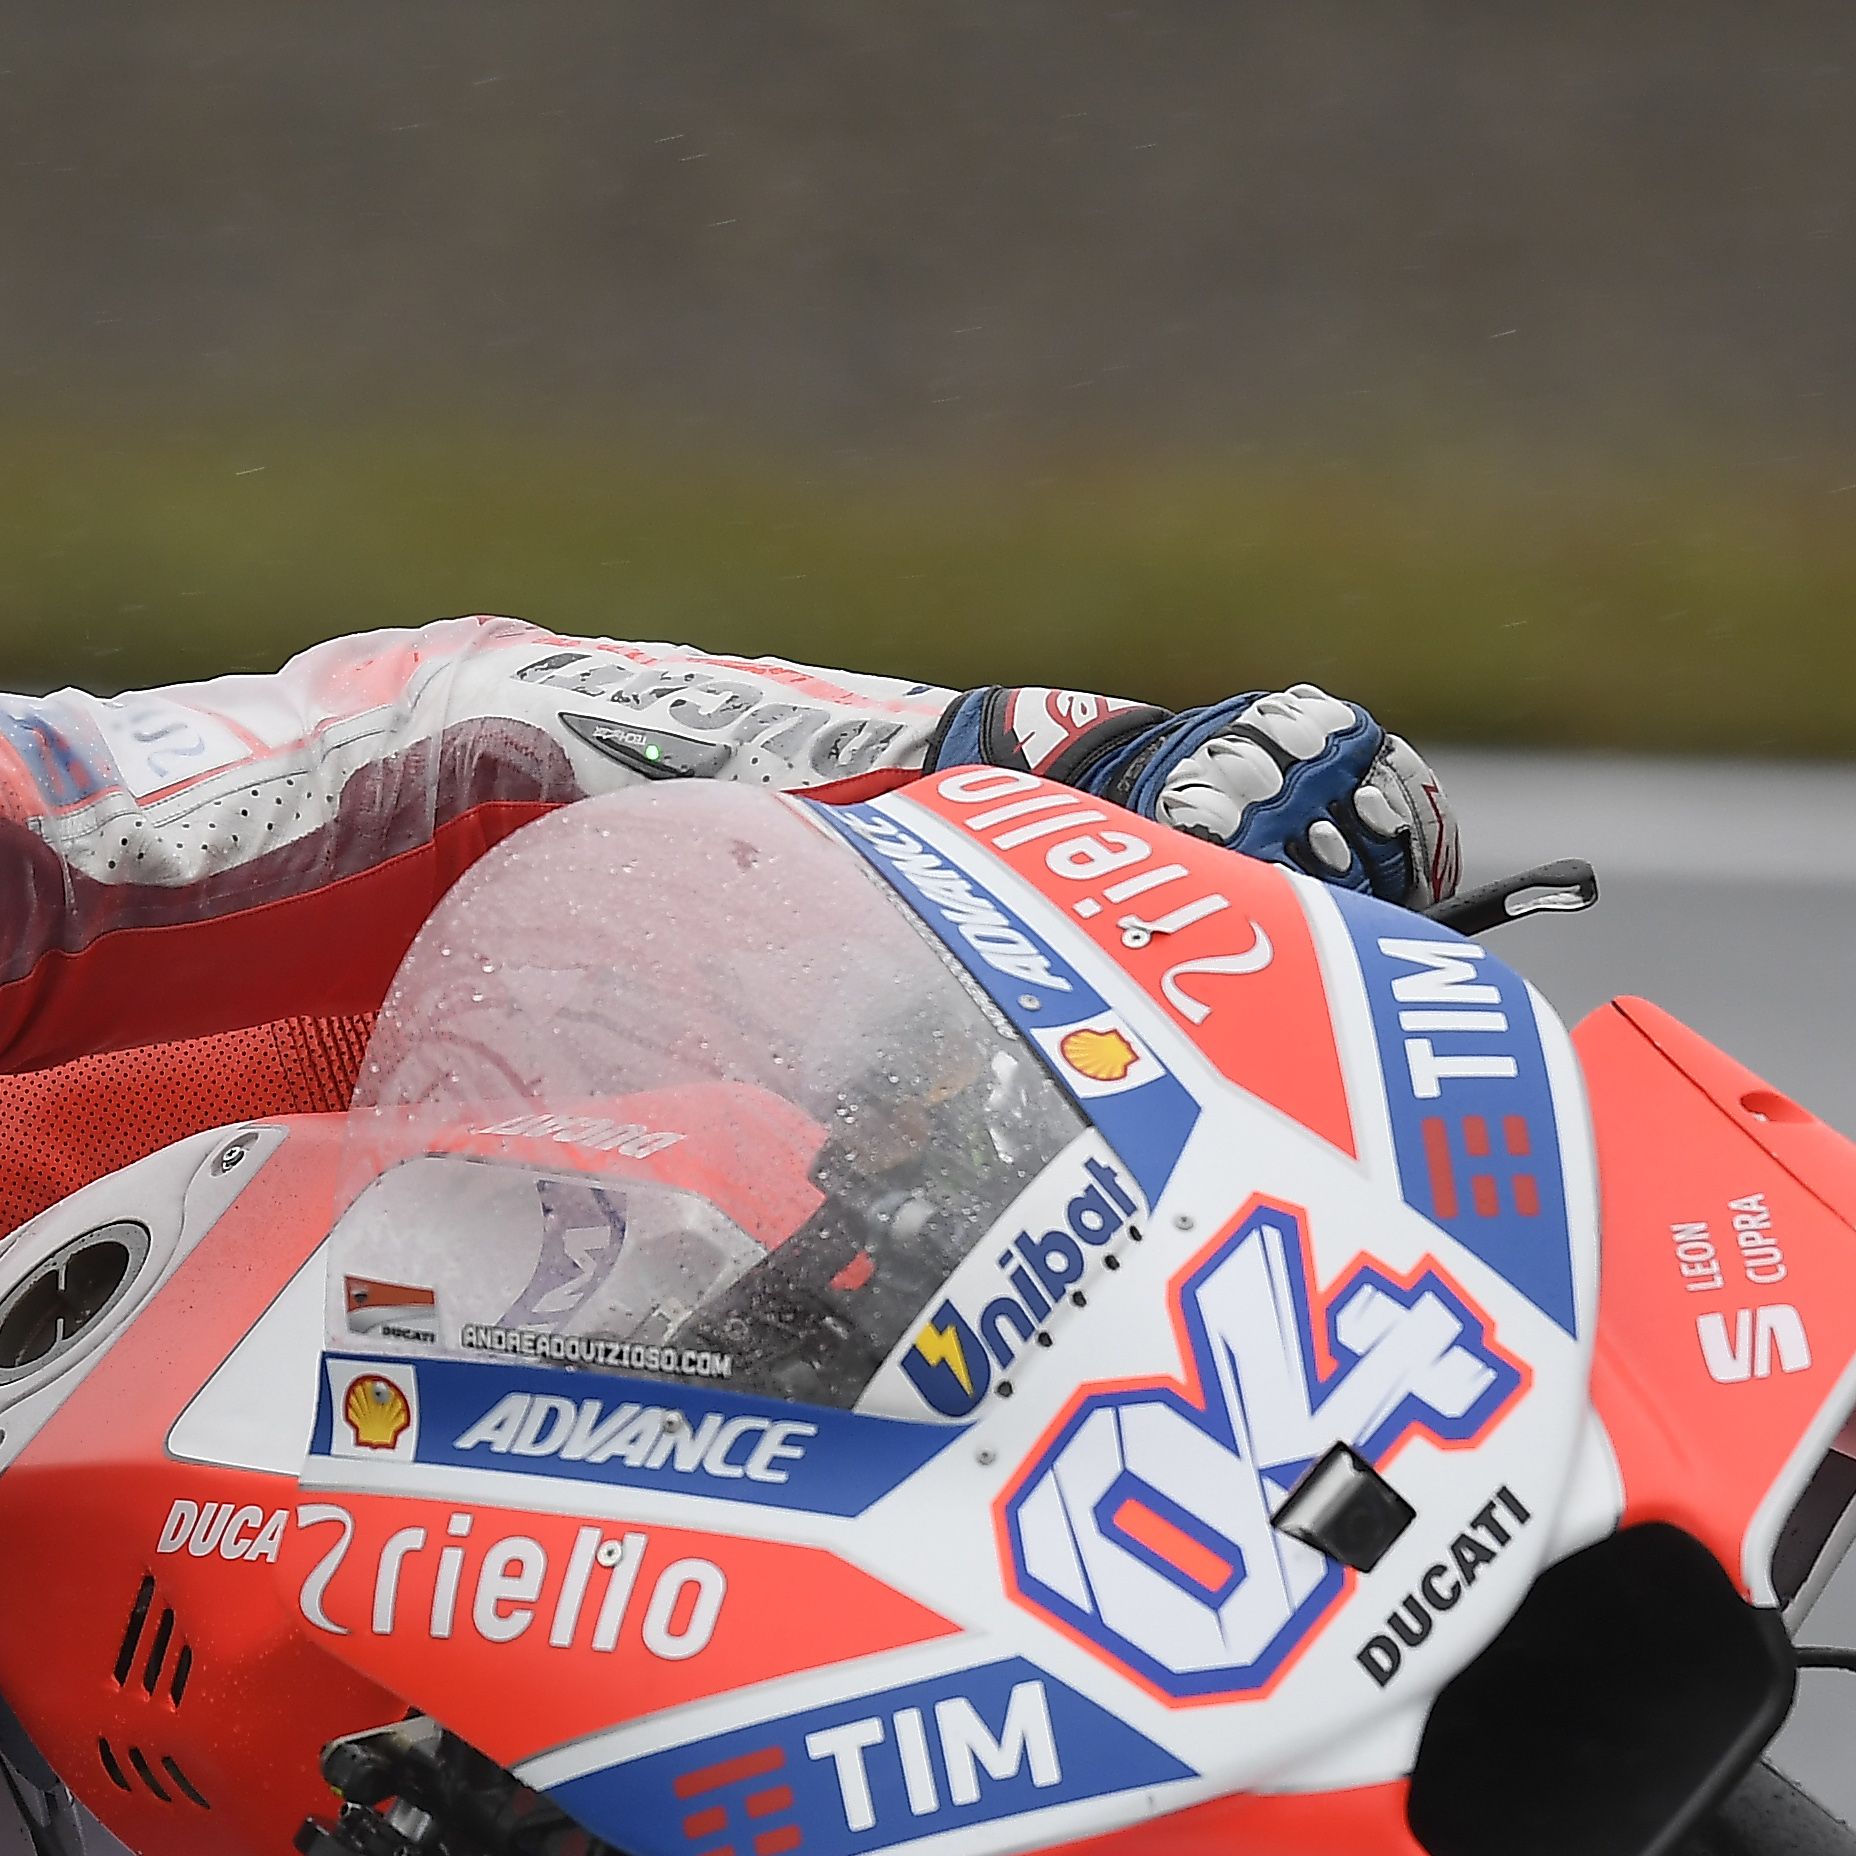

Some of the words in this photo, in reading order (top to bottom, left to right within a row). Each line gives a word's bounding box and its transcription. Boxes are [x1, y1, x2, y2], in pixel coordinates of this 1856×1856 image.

[840, 804, 1073, 993] ADVANCE
[1377, 938, 1520, 1100] TIM
[899, 1156, 1140, 1419] Unibat
[1670, 1221, 1724, 1293] LEON
[1727, 1192, 1788, 1286] CUPRA
[453, 1392, 821, 1485] ADVANCE
[997, 1194, 1531, 1708] 04
[1354, 1485, 1534, 1688] DUCATI
[805, 1678, 1061, 1833] TIM
